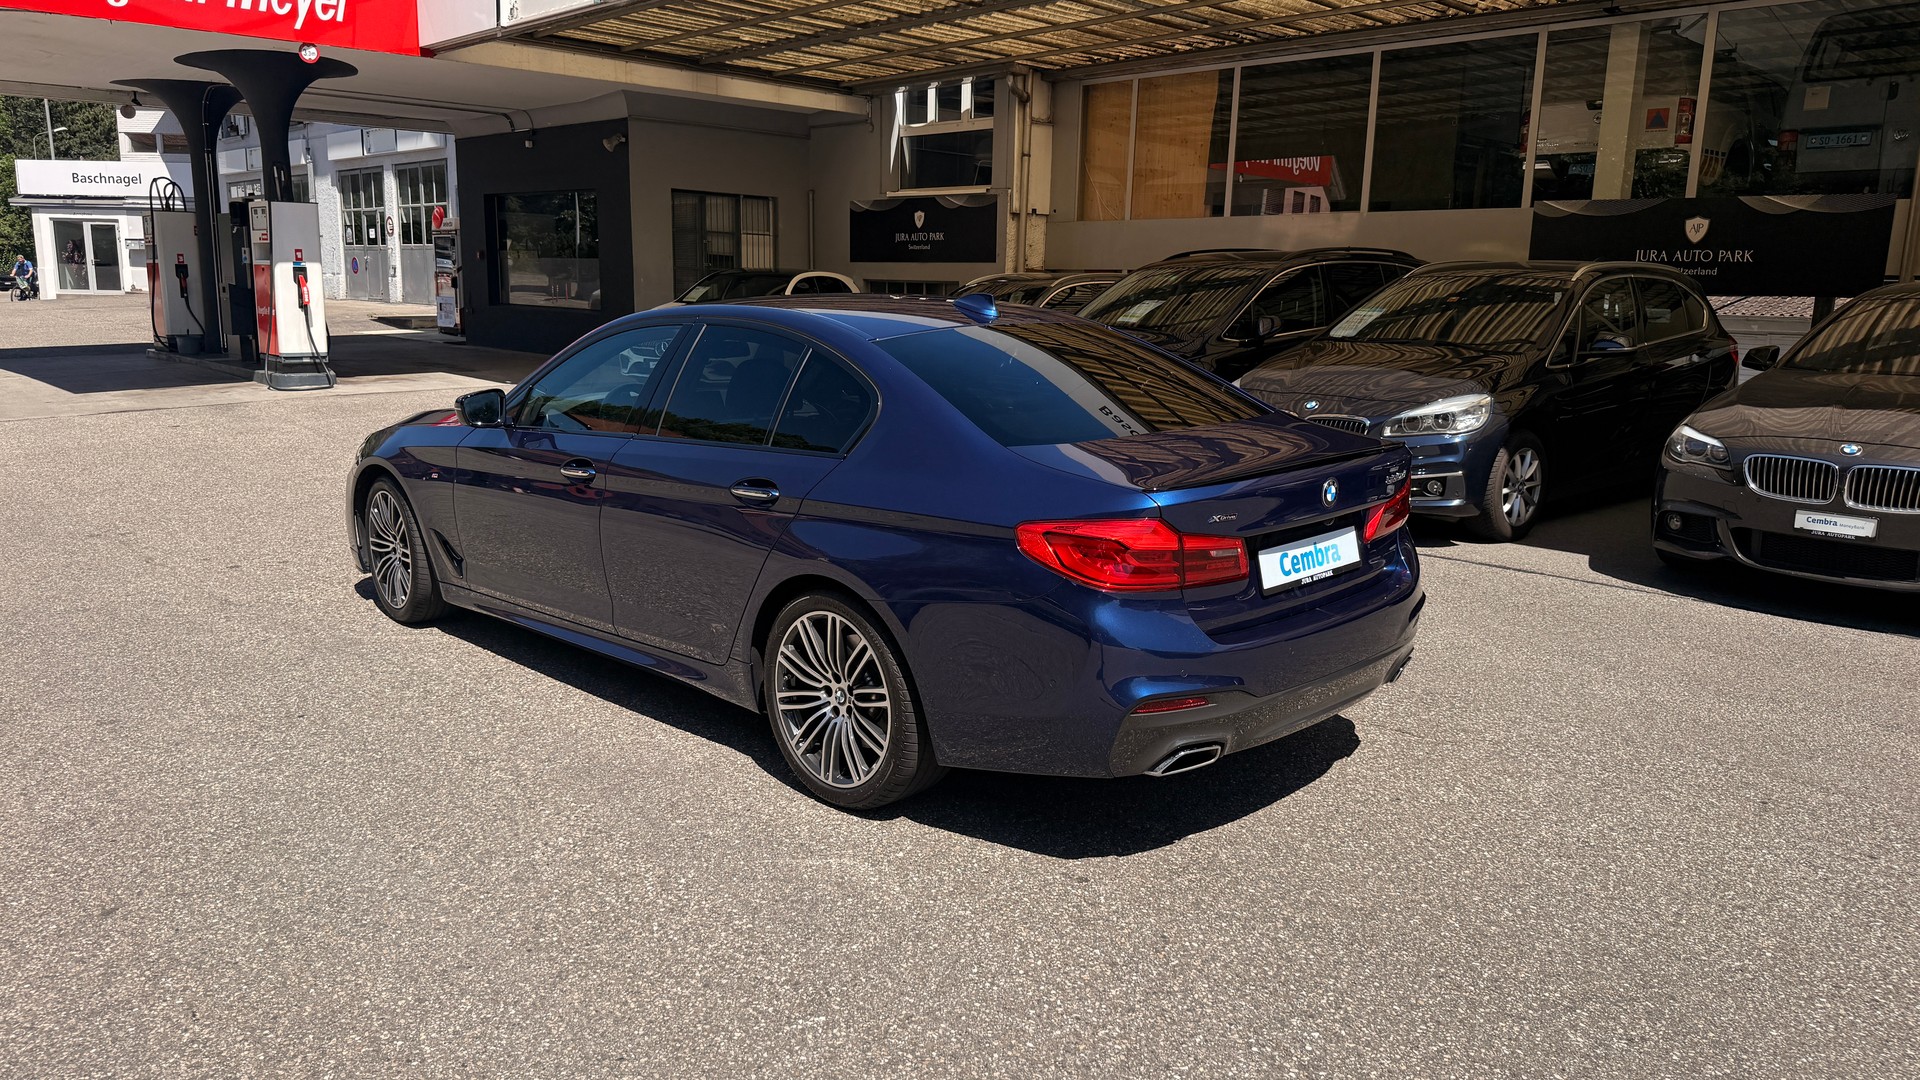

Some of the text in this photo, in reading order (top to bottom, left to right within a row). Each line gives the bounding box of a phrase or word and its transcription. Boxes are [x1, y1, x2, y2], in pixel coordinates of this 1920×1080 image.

[71, 172, 142, 187] Baschnagel
[895, 232, 944, 243] JURA AUTO PARK
[1635, 249, 1754, 263] JURA AUTO PARK
[1806, 516, 1838, 527] Cembra
[1827, 532, 1856, 540] AUTOPARK
[1279, 541, 1341, 577] Cembra
[1301, 569, 1334, 585] JURA AUTOPARK
